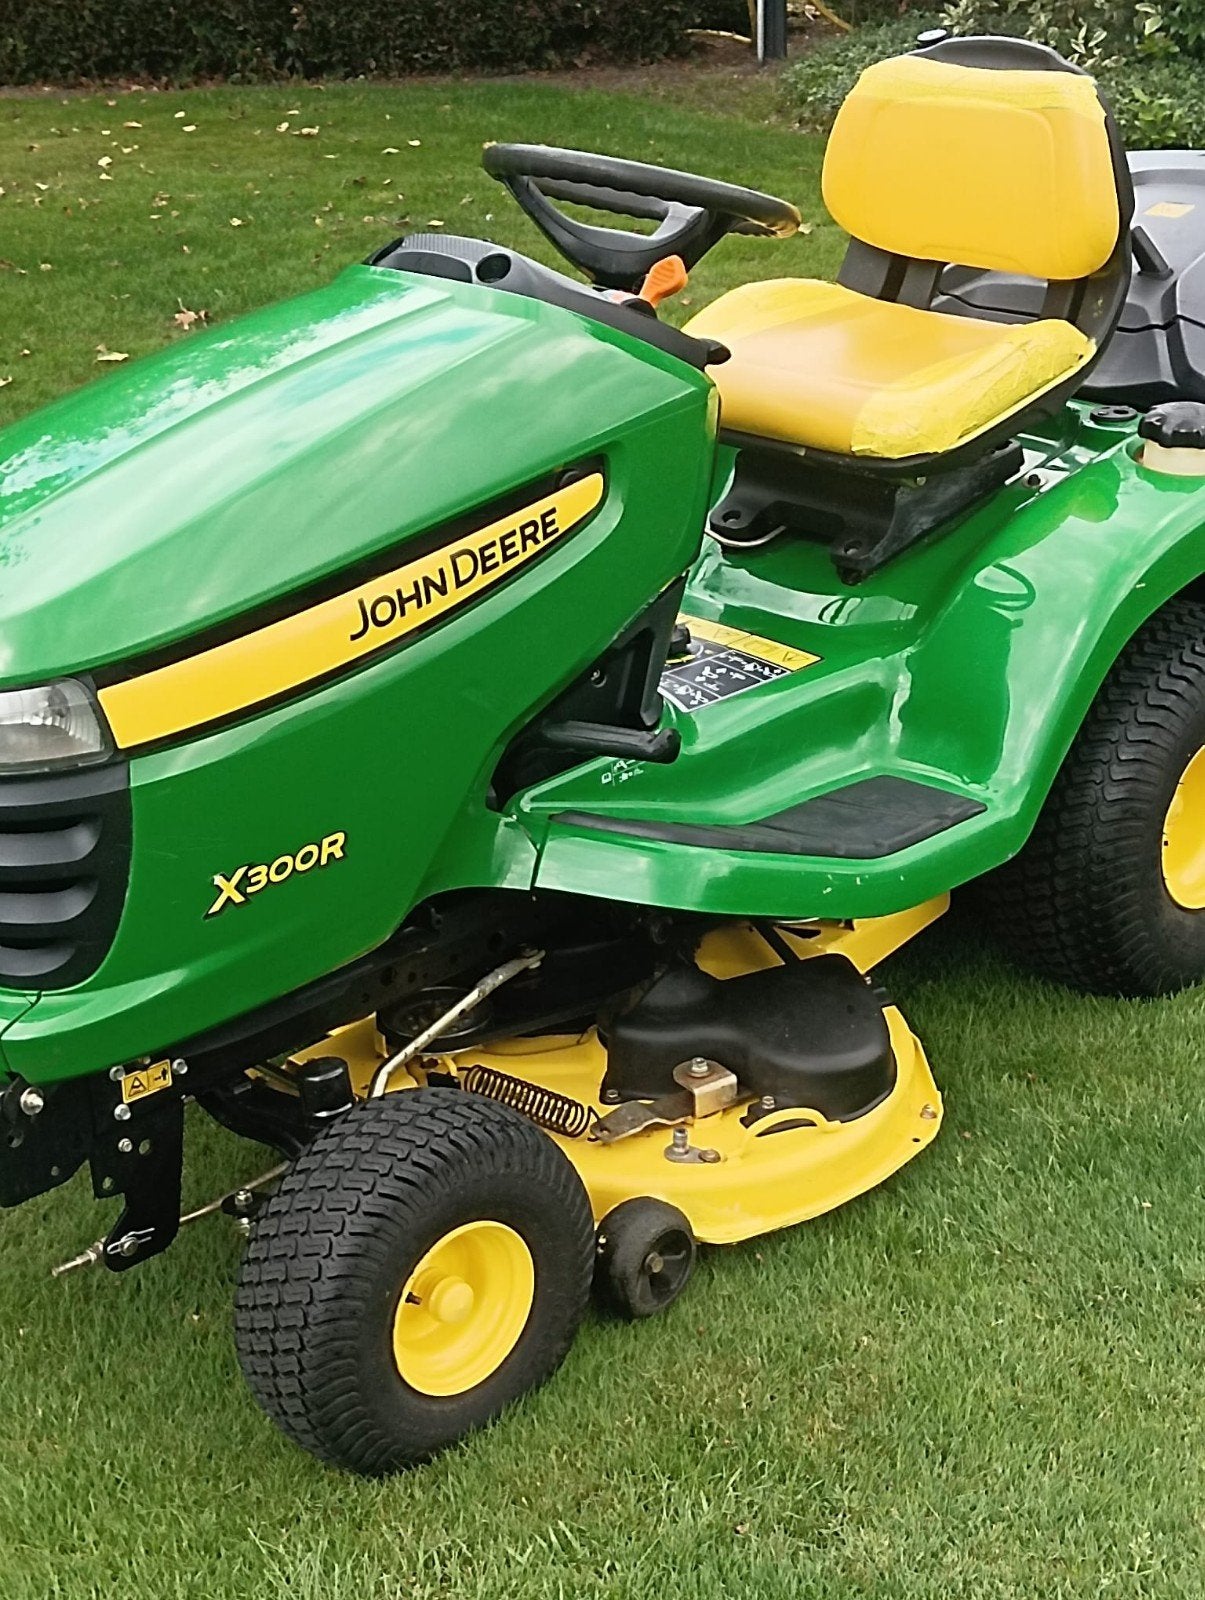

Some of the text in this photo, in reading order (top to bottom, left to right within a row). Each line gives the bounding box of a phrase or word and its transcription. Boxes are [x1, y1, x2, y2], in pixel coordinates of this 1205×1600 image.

[350, 507, 559, 641] JOHN DEERE
[206, 830, 346, 916] X300R
